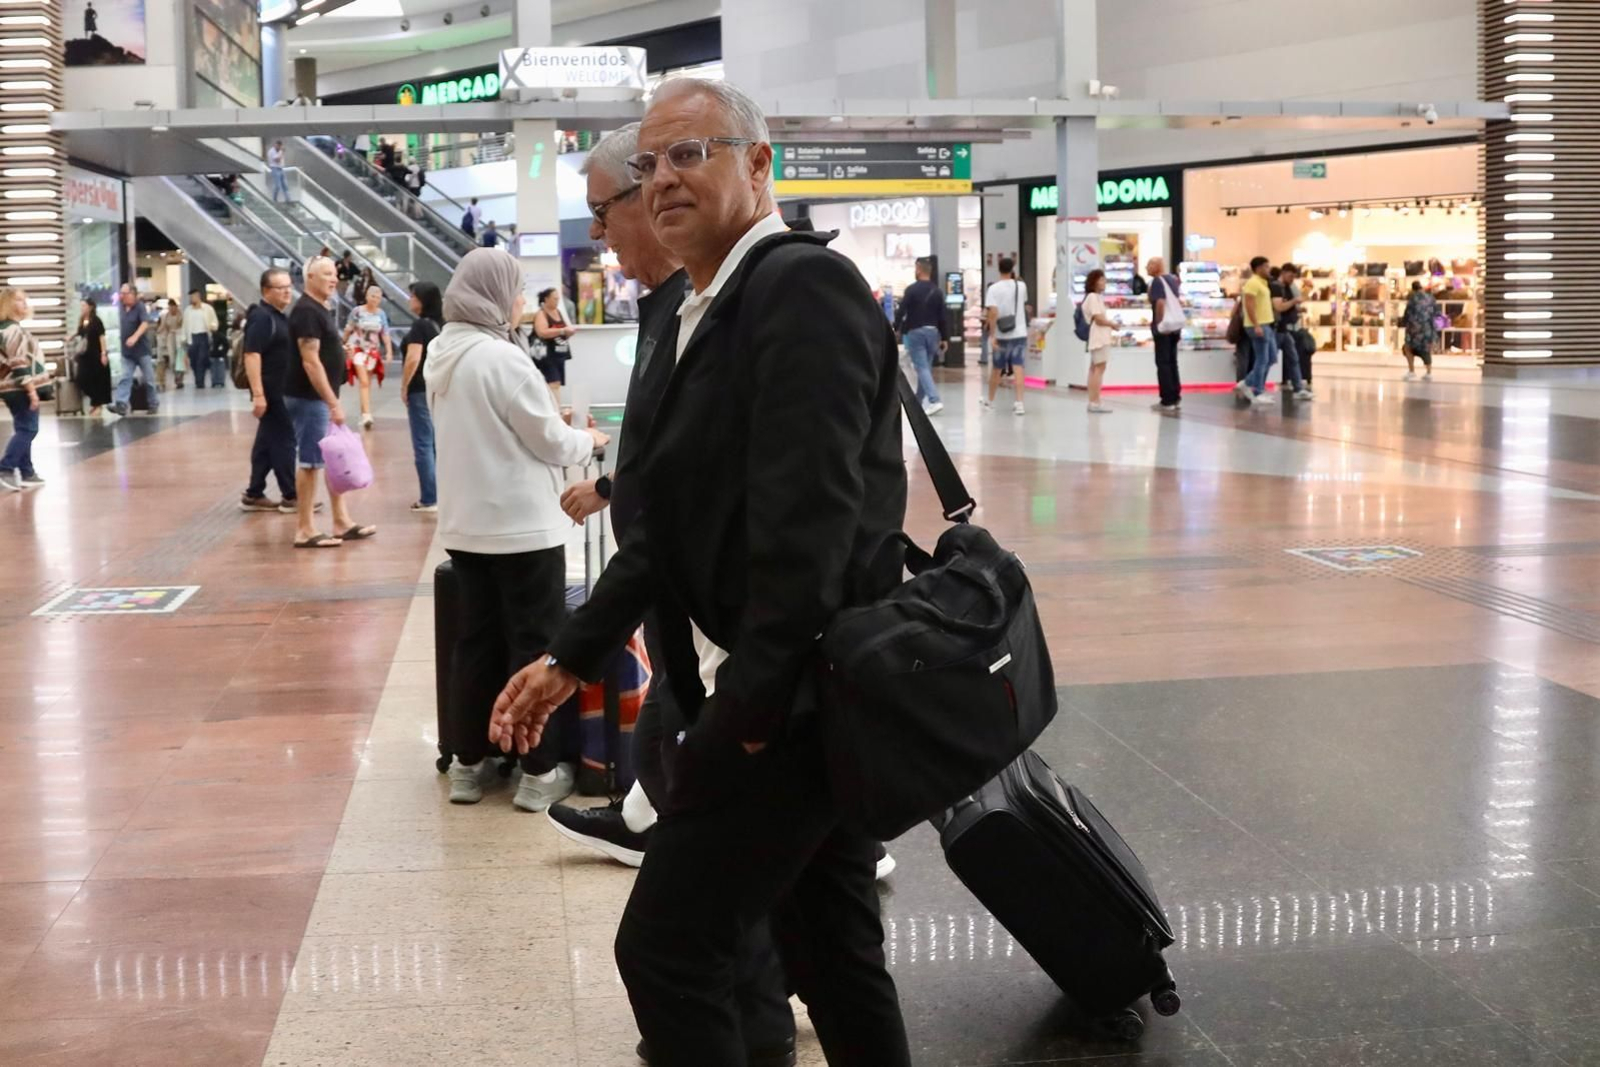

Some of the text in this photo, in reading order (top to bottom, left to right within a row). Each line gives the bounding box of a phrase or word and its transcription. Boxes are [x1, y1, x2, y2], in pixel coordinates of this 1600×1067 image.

[522, 52, 627, 66] Bienvenidos
[565, 70, 626, 82] WELCOME
[422, 73, 499, 105] MERCAD
[1030, 176, 1169, 209] MEDONA
